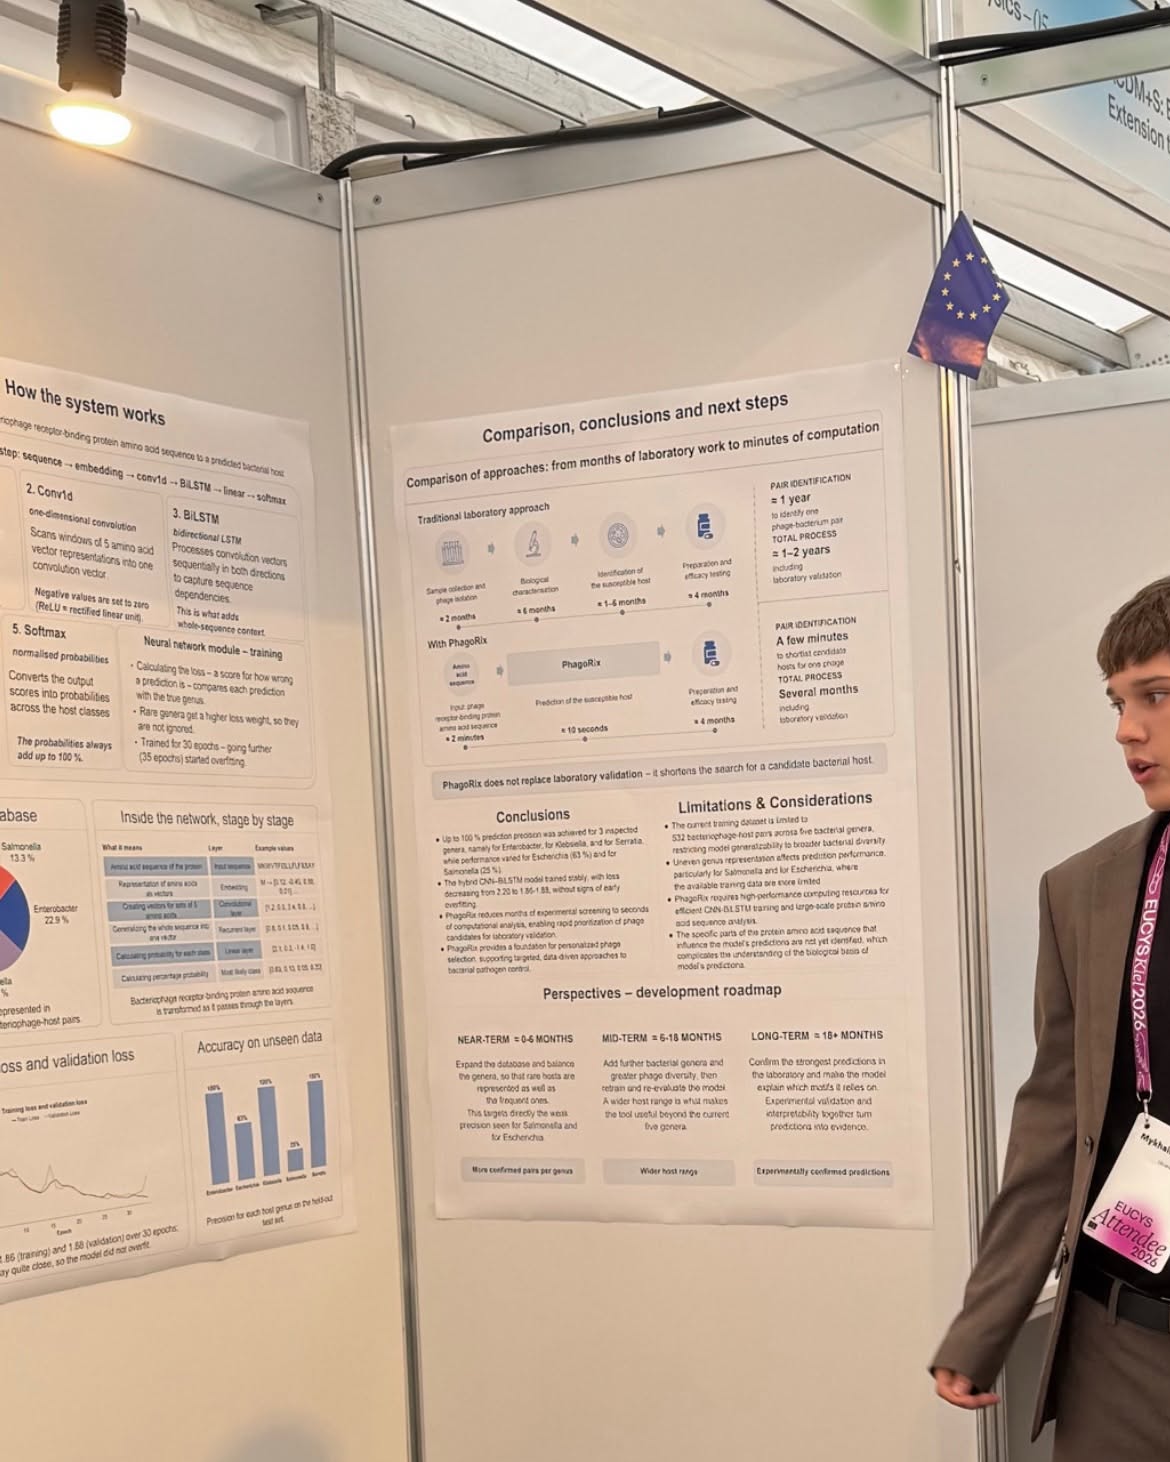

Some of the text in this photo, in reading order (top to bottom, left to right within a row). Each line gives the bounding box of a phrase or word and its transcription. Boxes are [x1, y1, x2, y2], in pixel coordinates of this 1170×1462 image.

[1108, 93, 1165, 151] Extension
[5, 379, 165, 425] How the system works
[482, 394, 788, 442] Comparison, conclusions and next steps
[406, 422, 879, 488] Comparison of approaches: from months of laboratory work to minutes of computation
[0, 446, 286, 505] step: sequence embedding conv1d BiLSTM linear softmax
[770, 473, 851, 490] PAIR IDENTIFICATION
[26, 483, 73, 501] 2. Conv1d
[172, 507, 219, 524] 3. BiLSTM
[417, 502, 550, 524] Traditional laboratory approach
[772, 529, 837, 543] TOTAL PROCESS
[12, 623, 66, 638] 5. Softmax
[786, 634, 804, 645] few
[806, 632, 848, 643] minutes
[144, 635, 283, 661] Neural network module training
[427, 635, 487, 649] With PhagoRix
[12, 648, 109, 664] normalised probabilities
[562, 658, 600, 669] PhagoRix
[779, 684, 858, 699] Several months
[442, 778, 482, 791] PhagoRix
[483, 778, 504, 787] does
[505, 776, 520, 786] not
[520, 775, 551, 786] replace
[552, 773, 597, 783] laboratory
[598, 769, 643, 780] validation
[652, 768, 658, 777] it
[659, 767, 697, 777] shortens
[698, 765, 712, 774] the
[714, 763, 744, 773] search
[745, 762, 757, 771] for
[767, 759, 810, 770] candidate
[812, 756, 850, 767] bacterial
[851, 755, 872, 765] host.
[678, 792, 872, 813] Limitations & Considerations
[120, 810, 294, 829] Inside the network, stage by stage
[496, 808, 570, 823] Conclusions
[1, 841, 42, 851] Salmonella
[33, 905, 78, 913] Enterobacter
[1131, 899, 1158, 1030] EUCYS Kiel 2026
[543, 983, 782, 1001] Perspectives development roadmap
[197, 1031, 322, 1053] Accuracy on unseen data
[457, 1034, 573, 1044] NEAR-TERM 0-6 MONTHS
[602, 1032, 722, 1042] MID-TERM 6-18 MONTHS
[751, 1031, 883, 1040] LONG-TERM 18+ MONTHS
[0, 1049, 135, 1073] oss and validation loss
[756, 1167, 890, 1176] Experimentally confirmed predictions
[1114, 1200, 1154, 1228] EUCYS
[1092, 1208, 1168, 1257] Attendee
[1131, 1246, 1159, 1268] 2026
